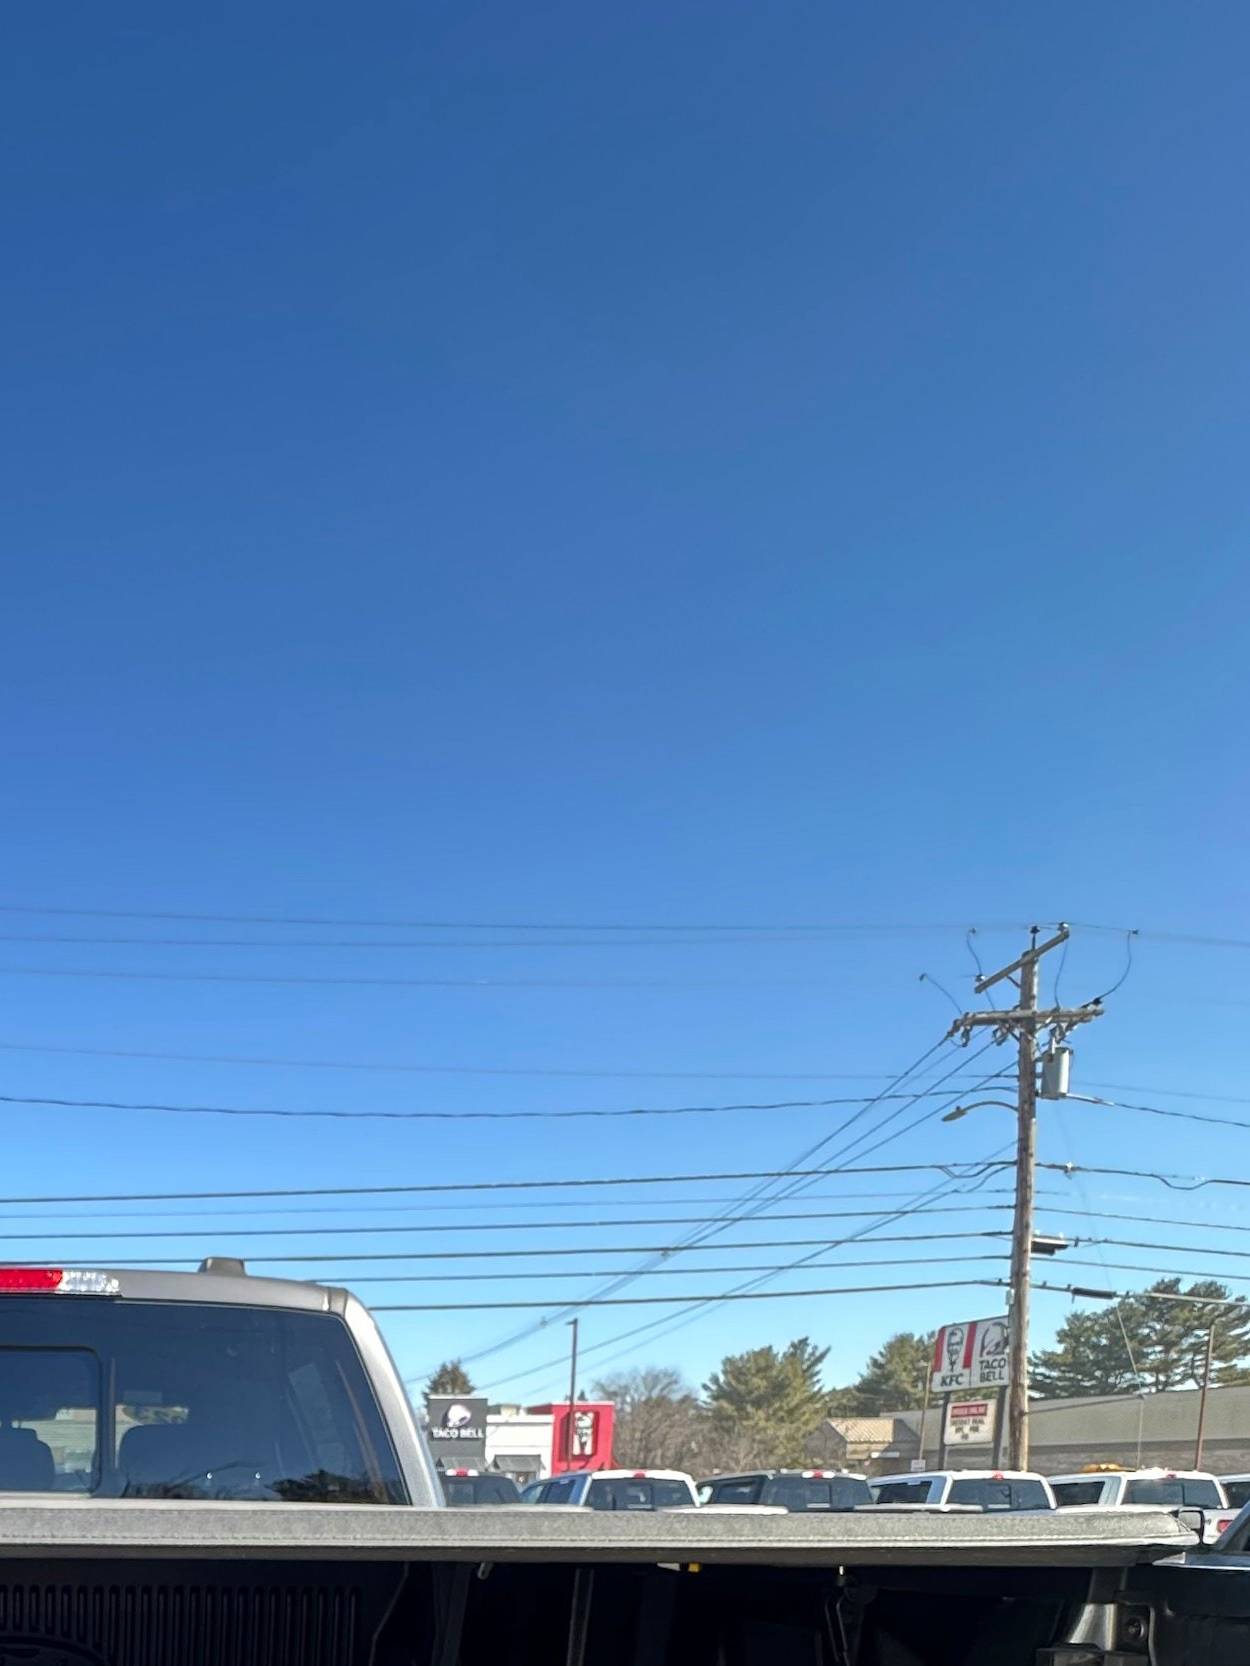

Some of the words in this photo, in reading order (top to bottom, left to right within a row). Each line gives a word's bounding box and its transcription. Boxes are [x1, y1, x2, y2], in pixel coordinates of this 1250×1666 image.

[979, 1357, 1007, 1370] TACO
[940, 1372, 964, 1387] KFC
[979, 1369, 1005, 1383] BELL
[431, 1427, 459, 1438] TACO
[460, 1427, 484, 1438] BELL
